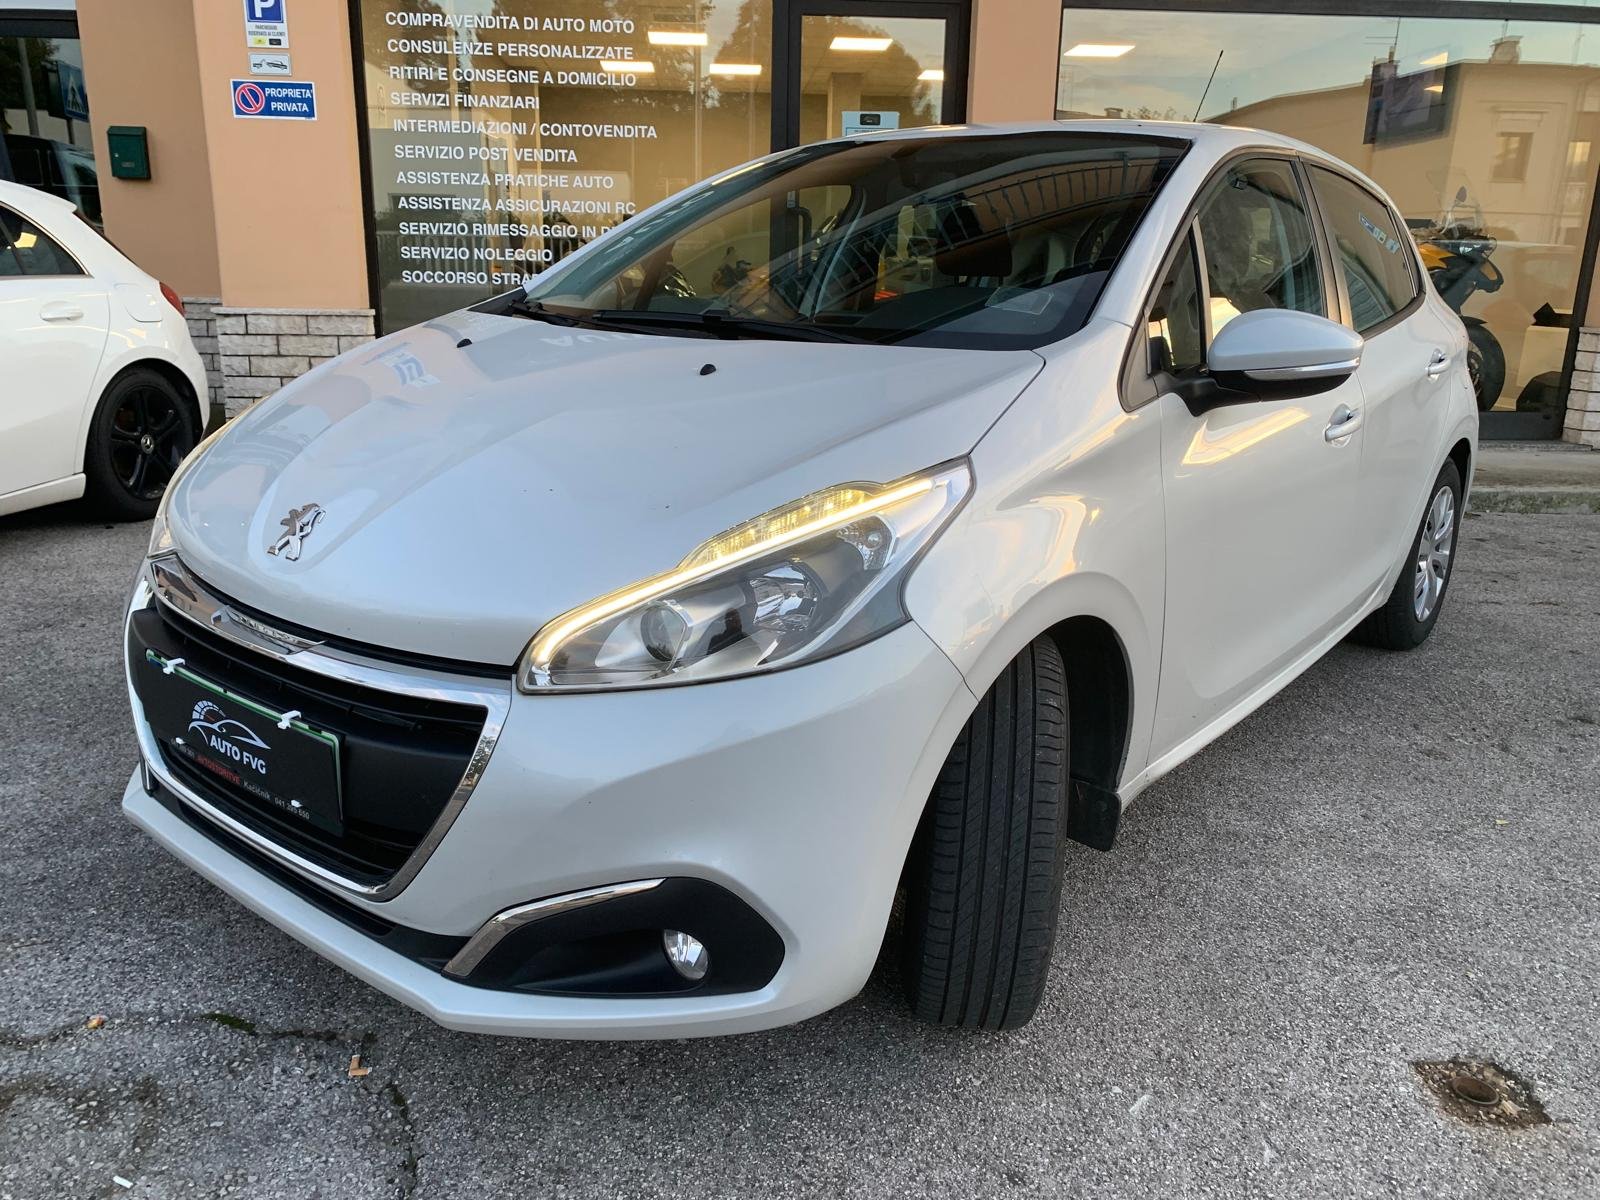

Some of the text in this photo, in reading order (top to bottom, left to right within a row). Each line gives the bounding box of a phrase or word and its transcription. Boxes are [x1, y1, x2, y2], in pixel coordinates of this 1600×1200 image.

[385, 11, 635, 34] COMPRAVENDITA DI AUTO MOTO
[387, 38, 634, 60] CONSULENZE PERSONALIZZATE
[389, 65, 637, 87] RITIRI E CONSEGNE A DOMICILIO
[265, 87, 313, 99] PROPRIETA'
[390, 91, 540, 109] SERVIZI FINANZIARI
[271, 101, 309, 113] PRIVATA
[393, 118, 658, 139] INTERMEDIAZIONI / CONTOVENDITA
[394, 144, 578, 163] SERVIZIO POST VENDITA
[396, 171, 614, 189] ASSISTENZA PRATICHE AUTO
[398, 196, 636, 215] ASSISTENZA ASSICURAZIONI RC
[399, 221, 469, 236] SERVIZIO
[472, 223, 578, 238] RIMESSAGGIO
[582, 225, 597, 238] IN
[400, 245, 553, 262] SERVIZIO NOLEGGIO
[402, 270, 488, 285] SOCCORSO
[210, 734, 241, 761] AUTO
[242, 751, 266, 775] FVG
